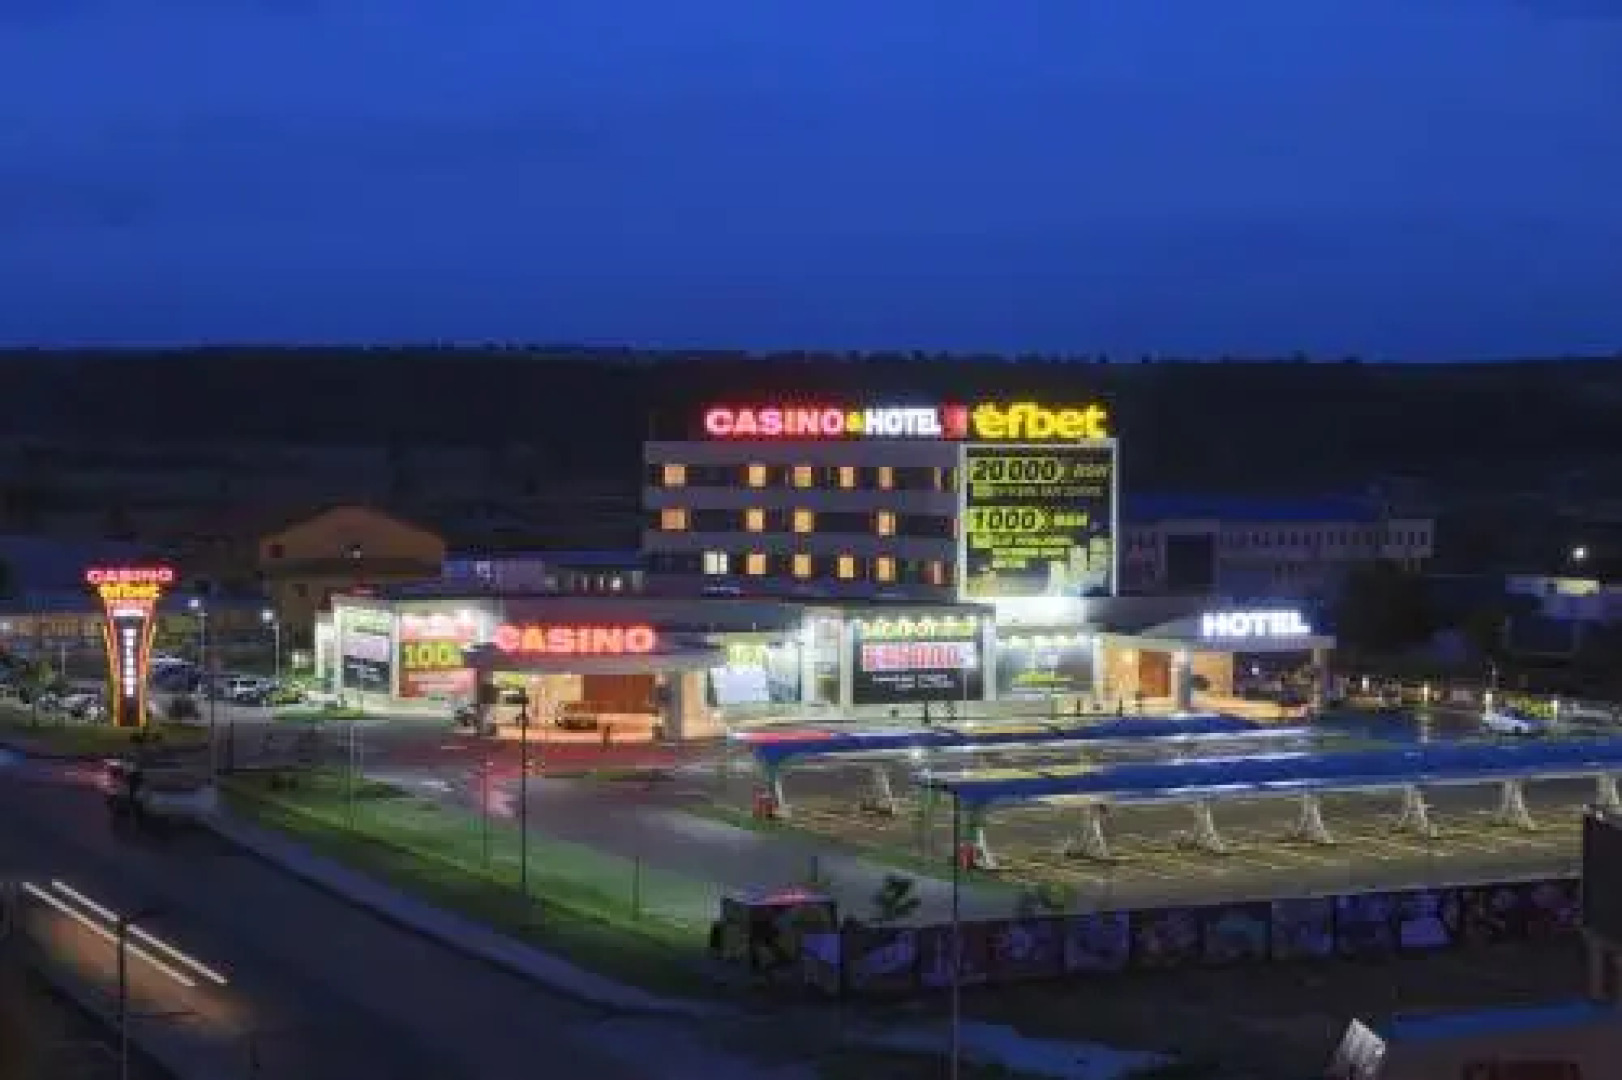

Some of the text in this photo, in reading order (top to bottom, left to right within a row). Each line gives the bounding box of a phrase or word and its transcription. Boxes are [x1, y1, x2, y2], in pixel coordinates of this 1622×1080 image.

[705, 408, 845, 436] CASINO
[865, 408, 941, 435] HOTEL
[971, 402, 1108, 438] efbet
[975, 511, 1036, 530] 1000
[1202, 611, 1311, 636] HOTEL
[493, 624, 656, 653] CASINO
